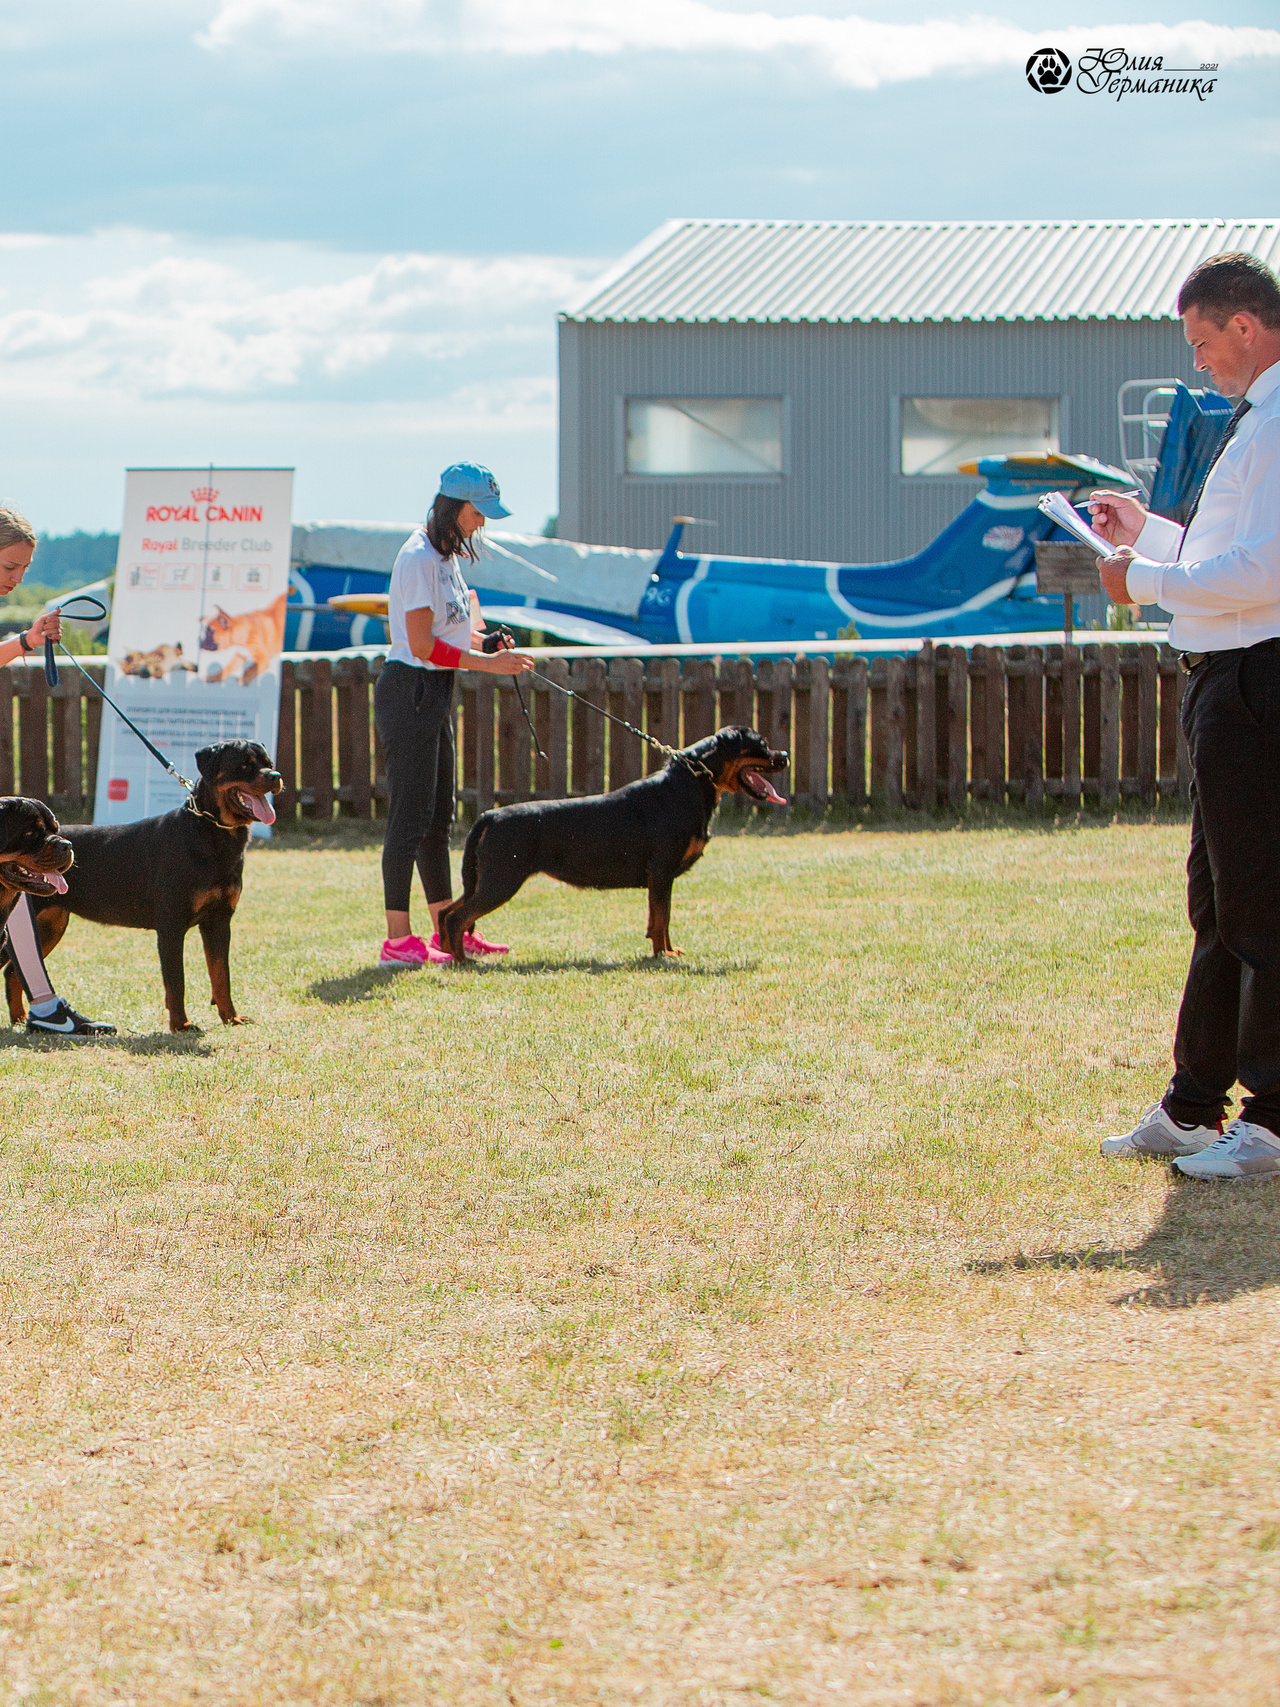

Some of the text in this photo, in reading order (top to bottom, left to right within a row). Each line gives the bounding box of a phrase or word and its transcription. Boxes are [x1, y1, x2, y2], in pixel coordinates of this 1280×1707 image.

[145, 505, 264, 523] ROYAL CANIN
[141, 537, 273, 554] Royal Breeder Club
